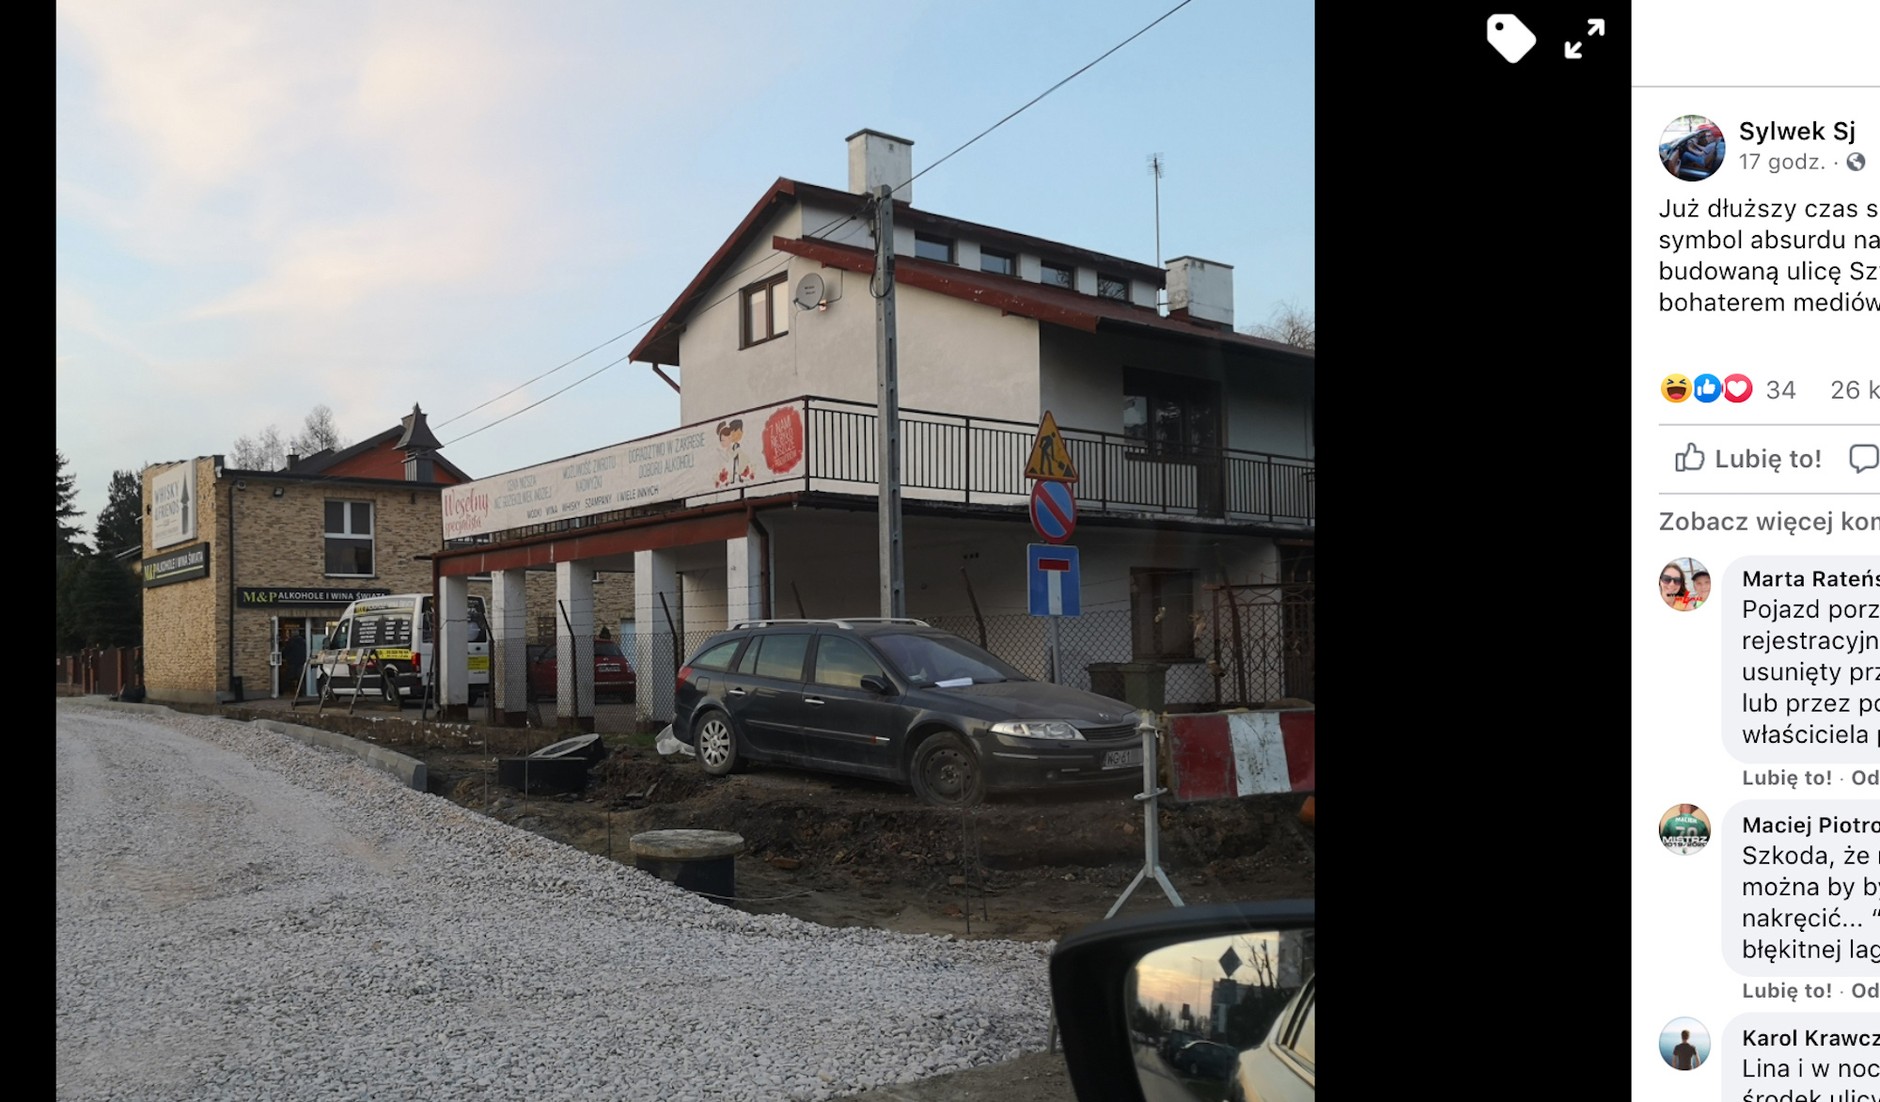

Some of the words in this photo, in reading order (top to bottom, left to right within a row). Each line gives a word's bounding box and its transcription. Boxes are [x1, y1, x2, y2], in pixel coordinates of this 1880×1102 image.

[445, 488, 489, 518] Weselny
[243, 591, 278, 603] M&P
[278, 592, 323, 600] ALKOHOLE
[326, 592, 329, 600] I
[331, 592, 354, 600] WINA
[1107, 752, 1120, 764] WG
